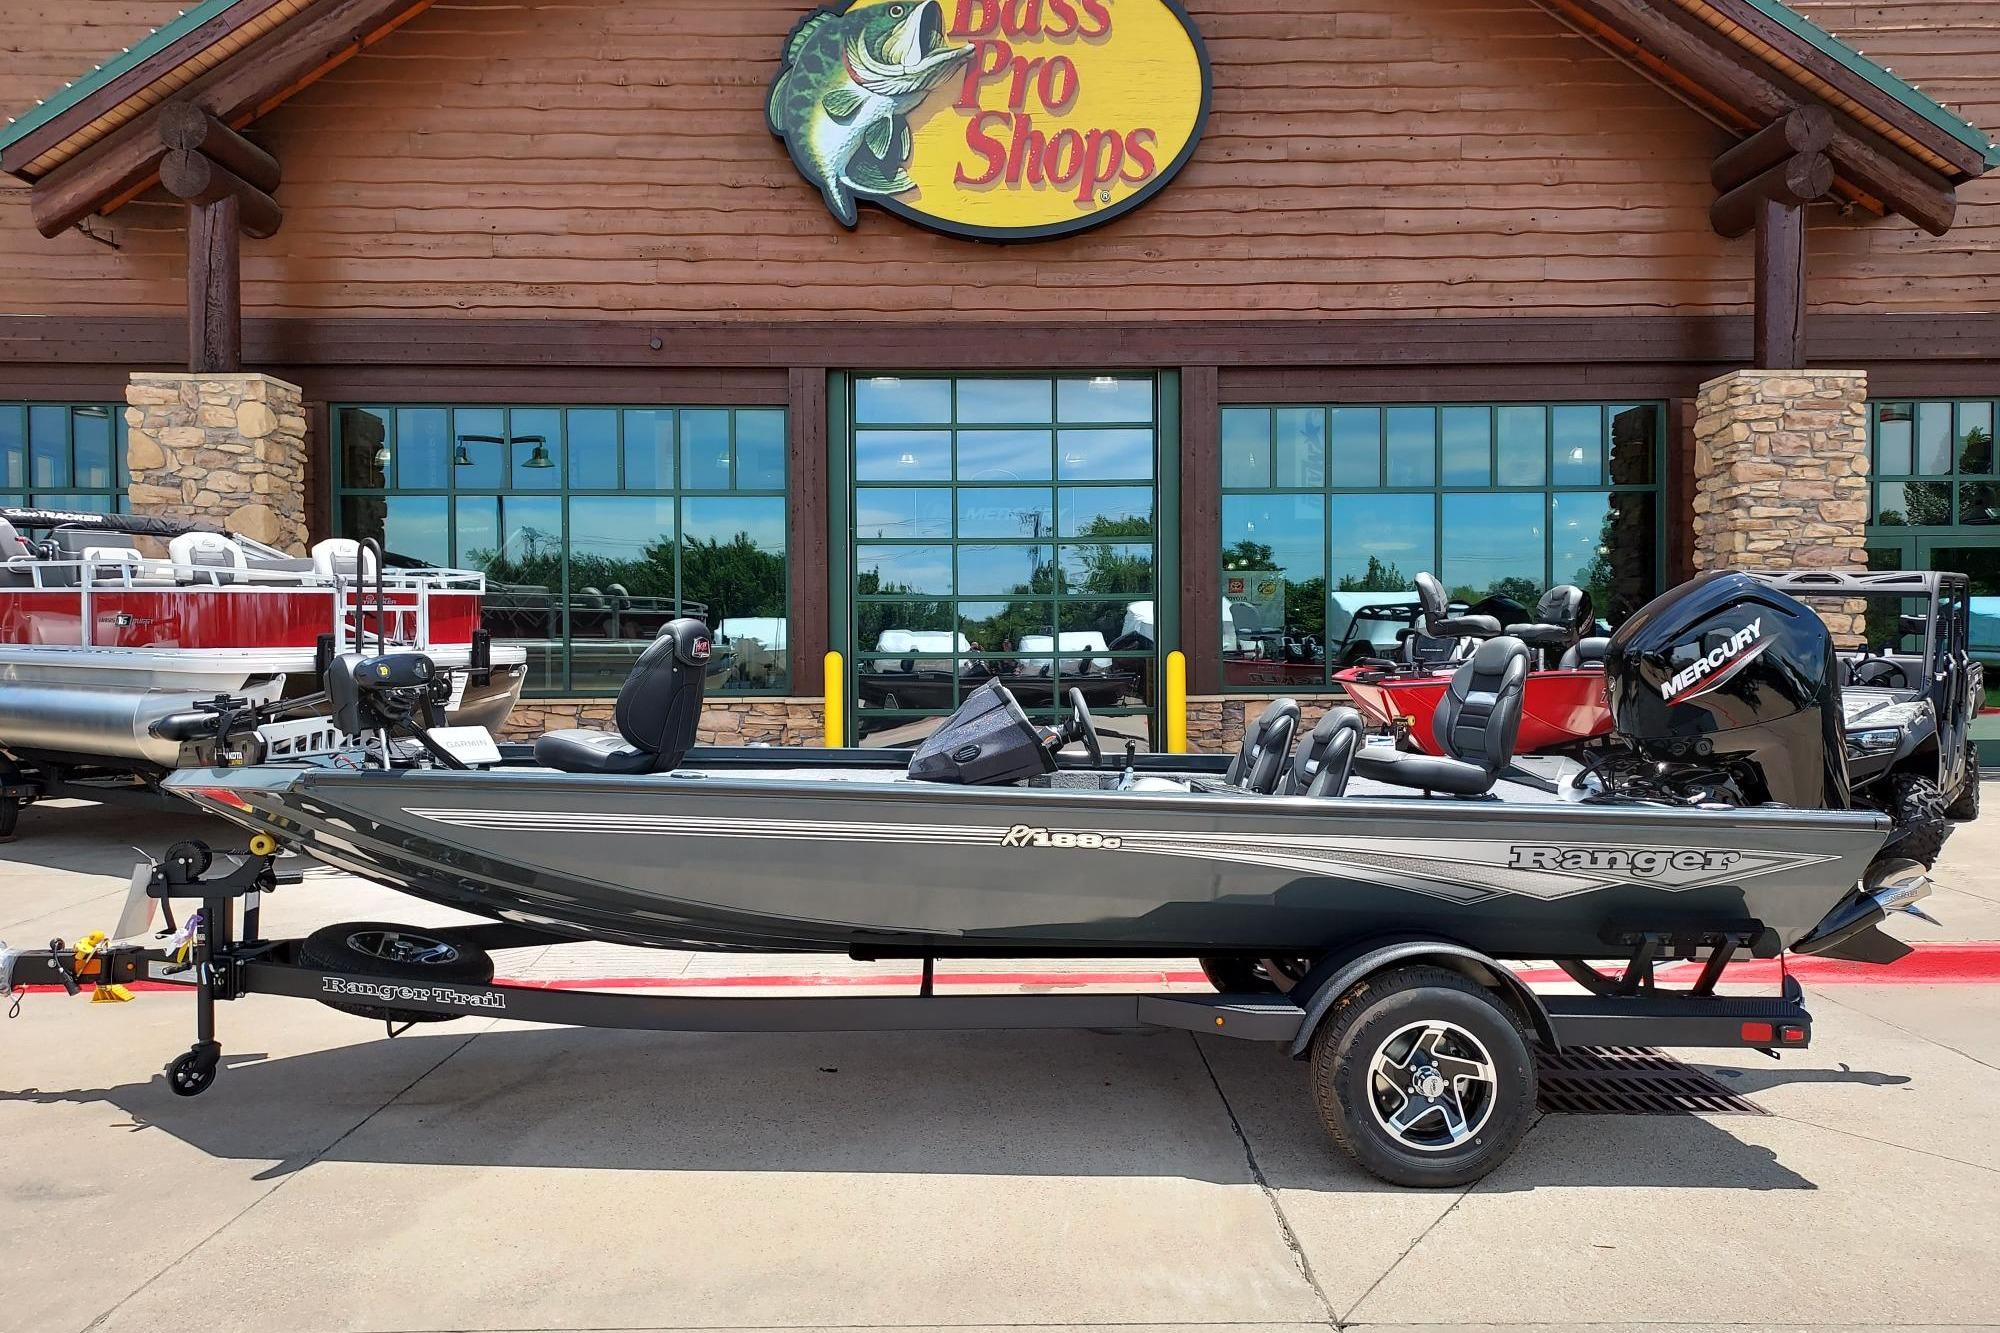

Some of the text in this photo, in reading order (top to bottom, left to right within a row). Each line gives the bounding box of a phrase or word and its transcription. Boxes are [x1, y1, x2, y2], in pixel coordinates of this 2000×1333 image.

[951, 39, 1080, 110] Pro
[953, 111, 1157, 202] Shops
[39, 510, 104, 522] TRACKER
[1660, 616, 1761, 700] MERCURY
[1508, 845, 1742, 877] Ranger
[322, 976, 506, 1009] Ranger Trail
